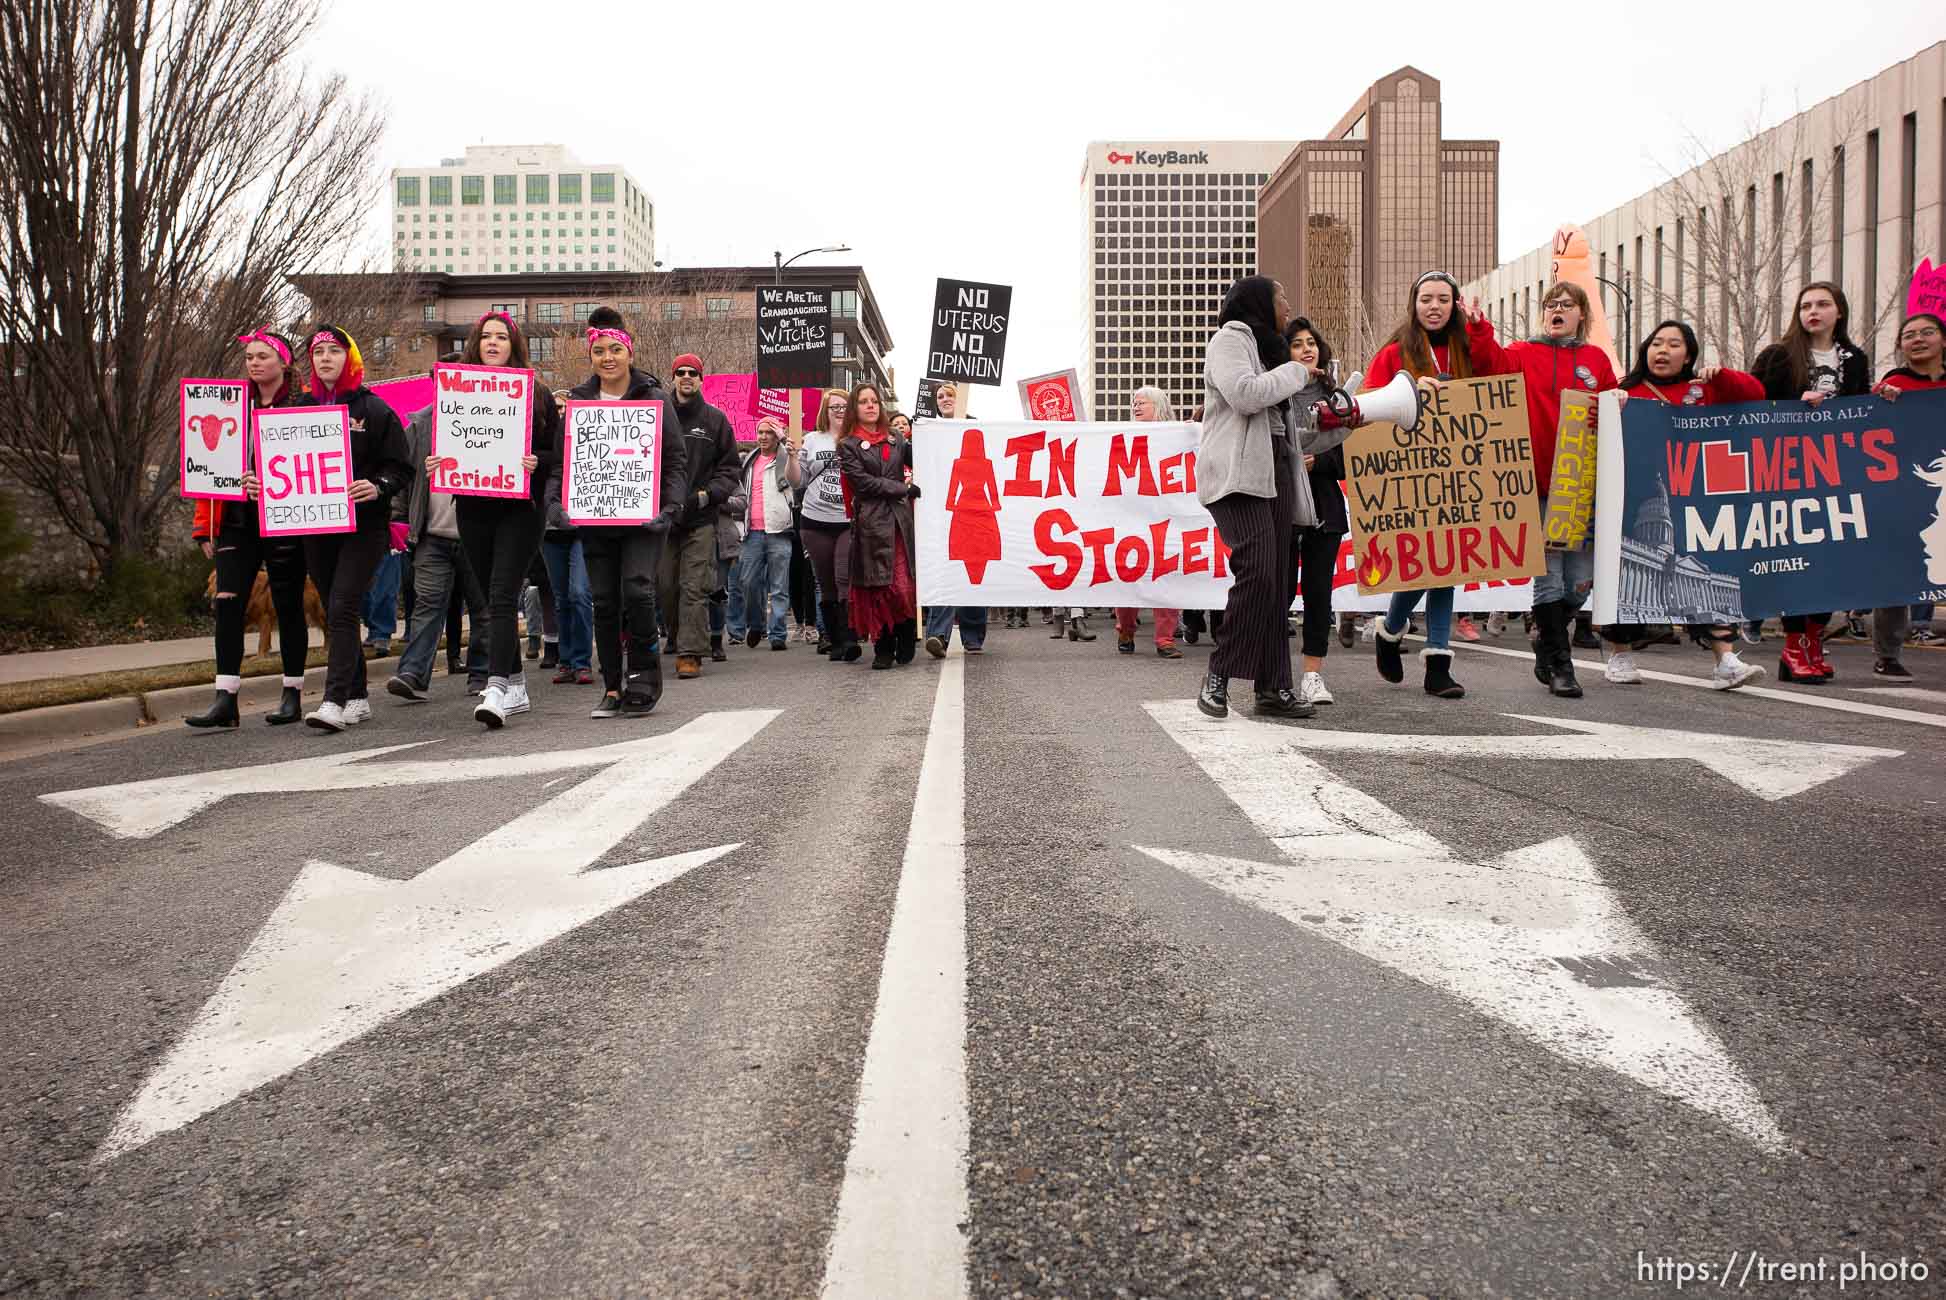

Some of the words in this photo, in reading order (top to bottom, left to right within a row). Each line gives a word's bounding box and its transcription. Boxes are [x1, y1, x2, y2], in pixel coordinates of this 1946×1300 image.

[1136, 150, 1208, 167] KeyBank
[763, 290, 783, 303] WE
[785, 291, 806, 303] ARE
[805, 292, 823, 303] THE
[957, 287, 989, 309] NO
[760, 306, 828, 318] GRANDDAUGHTERS
[938, 309, 1006, 333] UTERUS
[780, 319, 790, 328] OF
[792, 317, 807, 327] THE
[760, 325, 826, 344] WITCHES
[952, 331, 984, 354] NO
[760, 344, 774, 354] YOU
[775, 342, 805, 353] COULDN'T
[805, 340, 826, 350] BURN
[930, 351, 1001, 379] OPINION
[187, 386, 202, 399] WE
[203, 386, 219, 399] ARE
[220, 387, 241, 401] NOT
[439, 371, 523, 399] Warning
[760, 388, 778, 399] WITH
[759, 395, 790, 408] PLANNED
[1419, 386, 1450, 416] RE
[1468, 379, 1518, 411] THE
[440, 400, 464, 416] We
[471, 405, 494, 415] are
[498, 406, 516, 417] all
[576, 408, 606, 426] OUR
[612, 408, 655, 424] LIVES
[1738, 412, 1770, 425] AND
[1771, 411, 1803, 424] JUSTICE
[1804, 409, 1833, 422] FOR
[261, 424, 343, 441] NEVERTHELESS
[451, 420, 504, 439] Syncing
[577, 425, 620, 445] BEGIN
[622, 425, 640, 443] TO
[1392, 413, 1502, 448] GRAND-
[465, 440, 491, 449] our
[576, 443, 610, 461] END
[1003, 430, 1078, 499] IN
[1351, 437, 1451, 478] DAUGHTERS
[1462, 443, 1484, 466] OF
[1490, 438, 1531, 463] THE
[266, 451, 345, 500] SHE
[440, 457, 515, 490] Periods
[572, 461, 597, 473] THE
[600, 460, 618, 474] DAY
[622, 460, 644, 471] WE
[574, 472, 616, 486] BECOME
[619, 471, 654, 482] SILENT
[577, 484, 610, 497] ABOUT
[610, 485, 650, 499] THINGS
[1355, 470, 1483, 511] WITCHES
[1492, 470, 1534, 497] YOU
[570, 496, 595, 509] THAT
[586, 506, 617, 517] -MLK
[266, 503, 349, 524] PERSISTED
[1357, 508, 1429, 533] WEREN'T
[1437, 503, 1480, 525] ABLE
[1491, 501, 1516, 520] TO
[1684, 493, 1868, 553] MARCH
[1396, 522, 1527, 582] BURN
